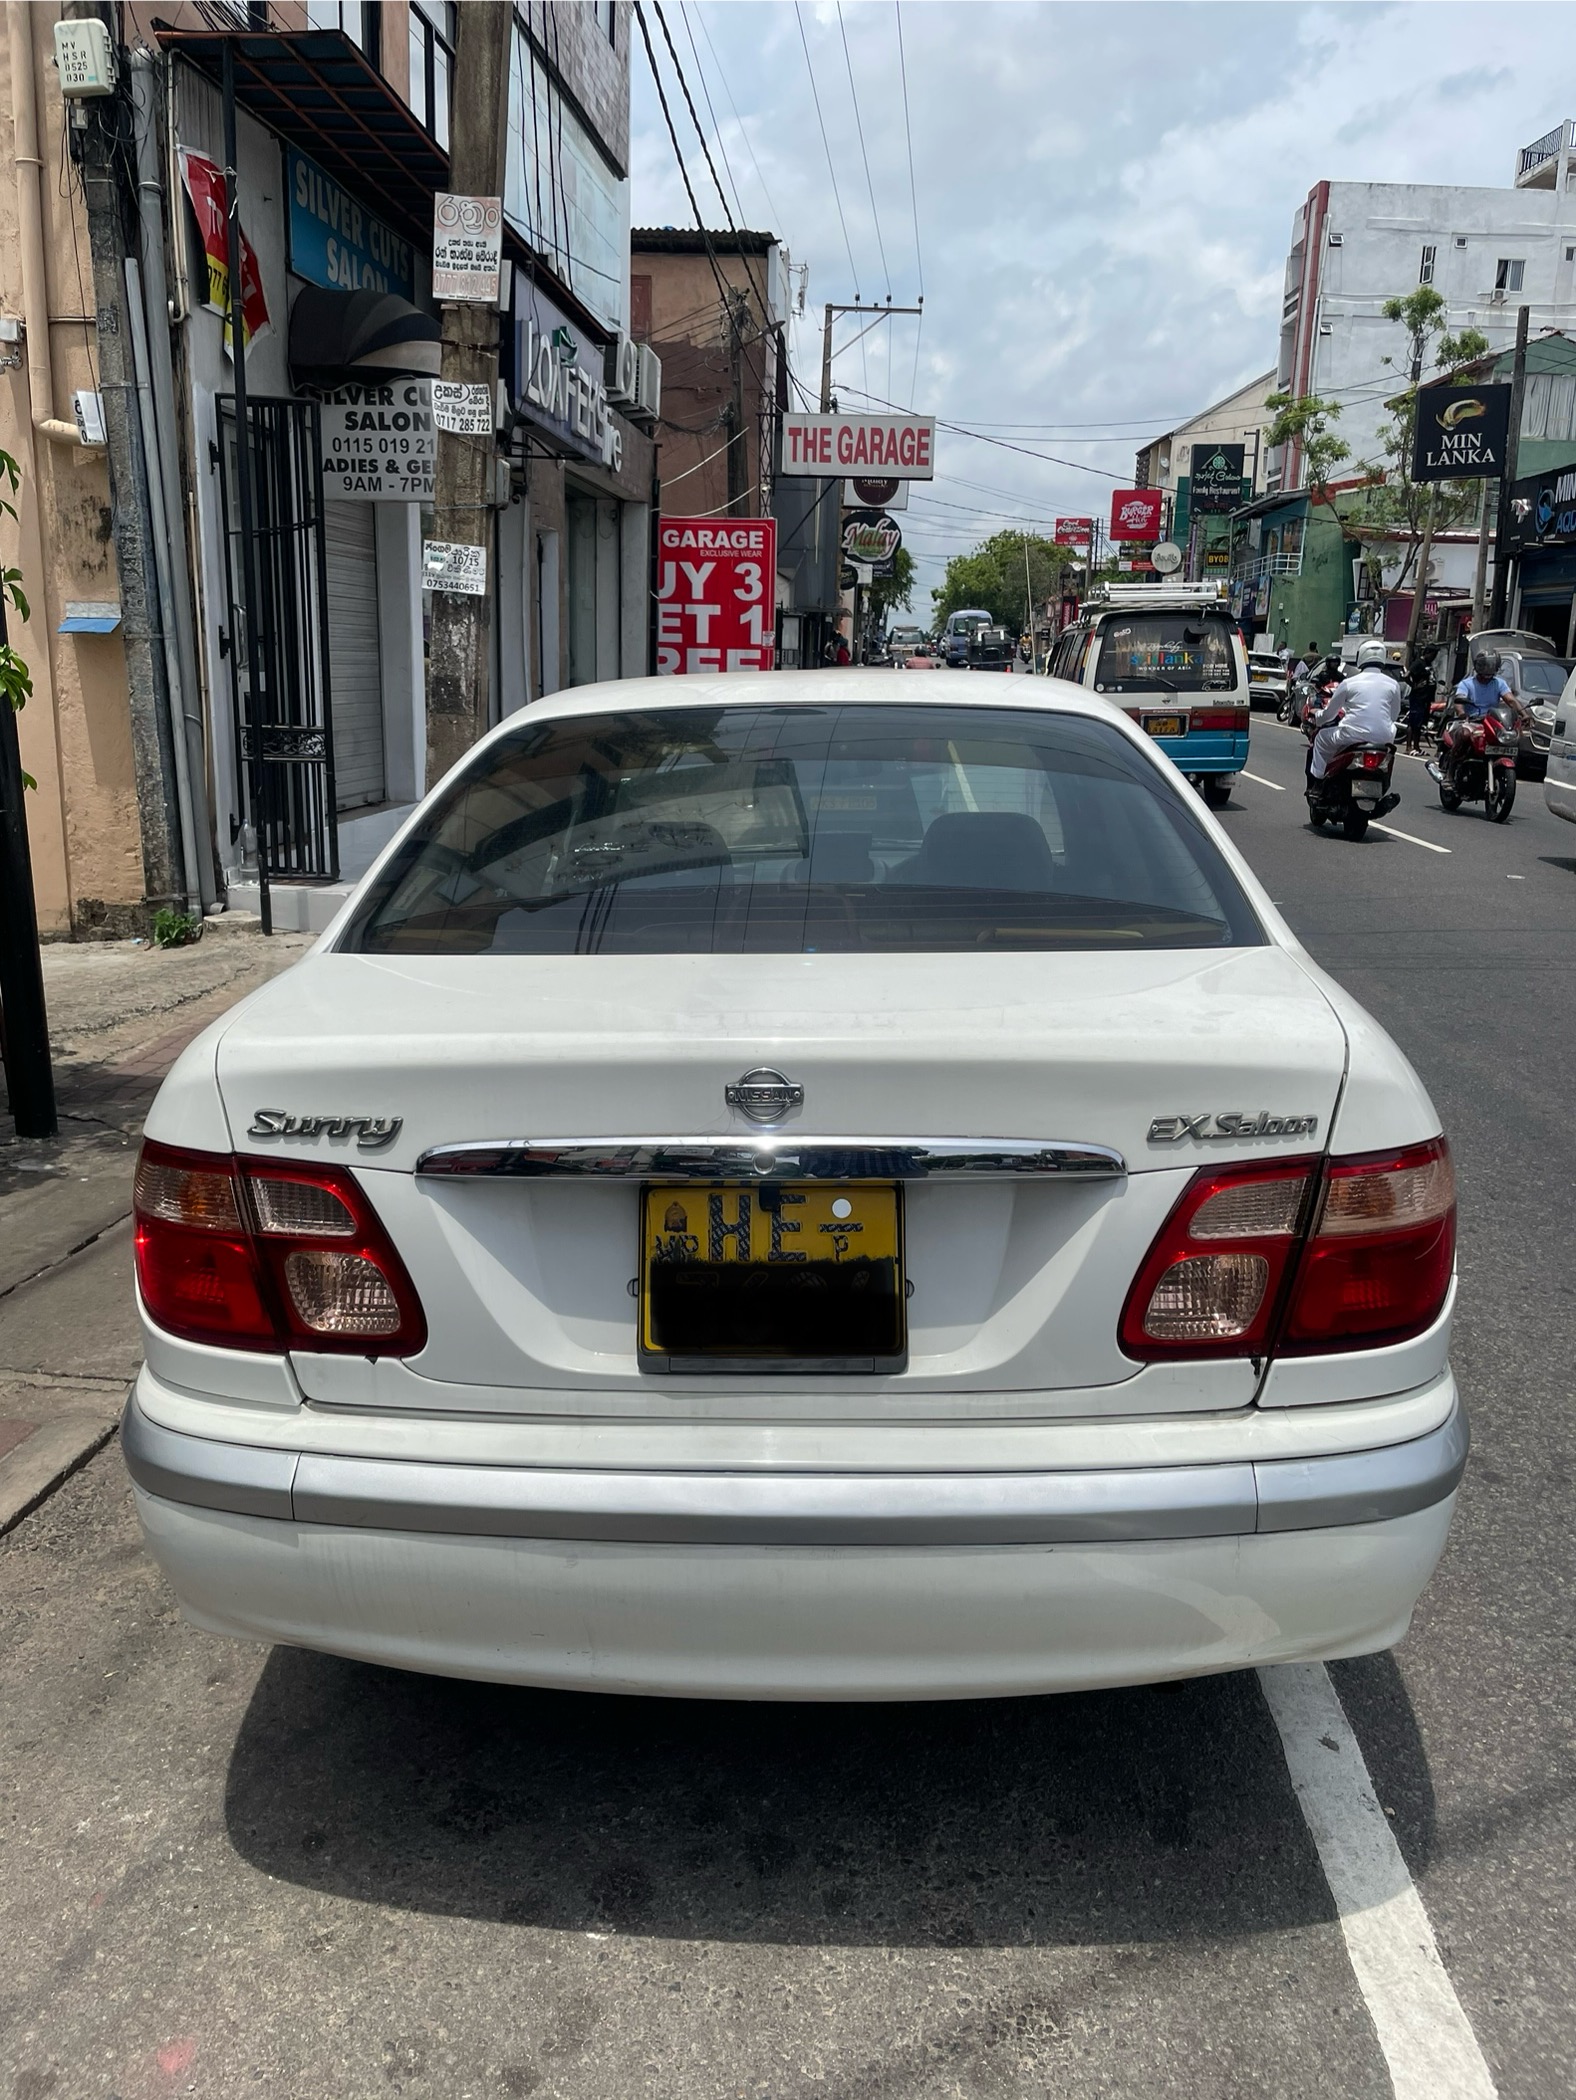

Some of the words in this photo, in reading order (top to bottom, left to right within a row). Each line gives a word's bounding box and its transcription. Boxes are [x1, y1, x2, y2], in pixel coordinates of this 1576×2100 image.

[296, 159, 364, 249] SILVER
[369, 222, 408, 282] CUTS
[327, 237, 388, 294] SALON
[434, 385, 463, 400] උකස්
[344, 411, 431, 432] SALON
[436, 413, 456, 429] 0717
[459, 418, 474, 431] 285
[477, 419, 490, 432] 722
[332, 437, 373, 453] 0115
[378, 438, 410, 454] 019
[788, 427, 832, 463] THE
[837, 425, 931, 467] GARAGE
[1441, 433, 1483, 450] MIN
[385, 459, 400, 474] &
[1426, 448, 1496, 467] LANKA
[343, 476, 382, 492] 9AM
[1119, 504, 1154, 520] BURGER
[662, 529, 764, 549] GARAGE
[844, 518, 900, 559] Malay
[452, 555, 479, 567] 10/15
[700, 549, 739, 557] EXCLUSIVE
[740, 550, 762, 558] WEAR
[426, 579, 479, 592] 0753440651
[733, 562, 763, 602] 3
[739, 604, 763, 645] 1
[734, 1088, 794, 1103] NISSAN
[247, 1108, 403, 1148] Sunny
[1147, 1113, 1211, 1142] EX
[1216, 1110, 1318, 1137] Saloon
